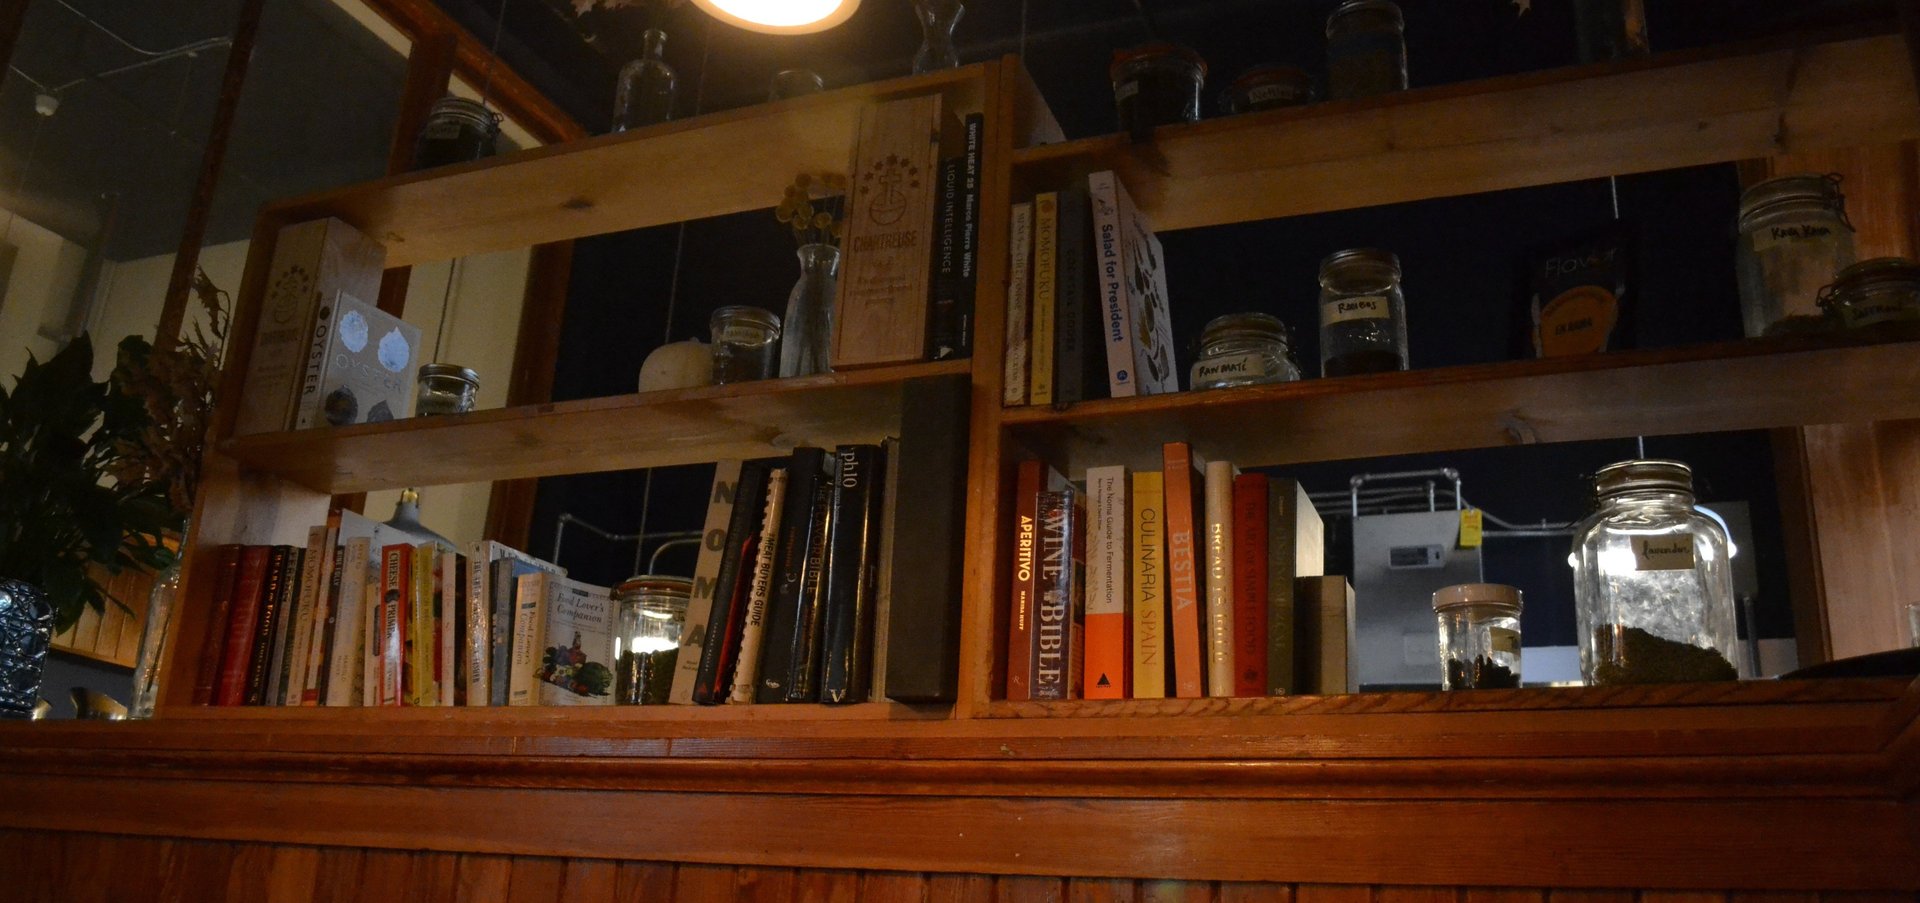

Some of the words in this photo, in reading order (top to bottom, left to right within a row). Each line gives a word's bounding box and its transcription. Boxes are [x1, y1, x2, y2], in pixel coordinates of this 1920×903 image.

[968, 122, 977, 151] WHITE
[945, 164, 955, 198] LIQUID
[966, 152, 975, 175] HEAT
[964, 194, 974, 221] Marco
[941, 201, 953, 272] INTELLIGENCE
[963, 223, 972, 250] Pierre
[1101, 224, 1115, 257] Salad
[962, 252, 971, 277] White
[1038, 217, 1051, 300] MOMOFUKU
[1105, 261, 1117, 278] for
[1106, 282, 1124, 341] President
[304, 325, 327, 396] OYSTER
[840, 450, 858, 488] ph10
[811, 503, 825, 555] FLAVOR
[1042, 508, 1067, 581] WINE
[1105, 517, 1113, 539] Guide
[1105, 541, 1112, 549] to
[1246, 526, 1256, 547] ART
[685, 481, 738, 647] NOMA
[764, 536, 774, 560] MEAT
[1016, 515, 1034, 581] APERITIVO
[1140, 508, 1156, 601] CULINARIA
[1210, 522, 1226, 578] BREAD
[389, 552, 398, 587] CHEESE
[755, 562, 769, 597] BUYERS
[806, 556, 820, 593] BIBLE
[1105, 552, 1113, 603] Fermentation
[1171, 531, 1194, 610] BESTIA
[576, 598, 604, 613] Lover's
[1018, 590, 1026, 614] MARISA
[1246, 568, 1256, 616] SIMPLE
[386, 604, 395, 639] PRIMER
[526, 610, 535, 630] Food
[749, 599, 763, 626] GUIDE
[515, 612, 528, 664] Companion
[1039, 599, 1064, 685] BIBLE
[1141, 609, 1156, 665] SPAIN
[1246, 618, 1256, 654] FOOD
